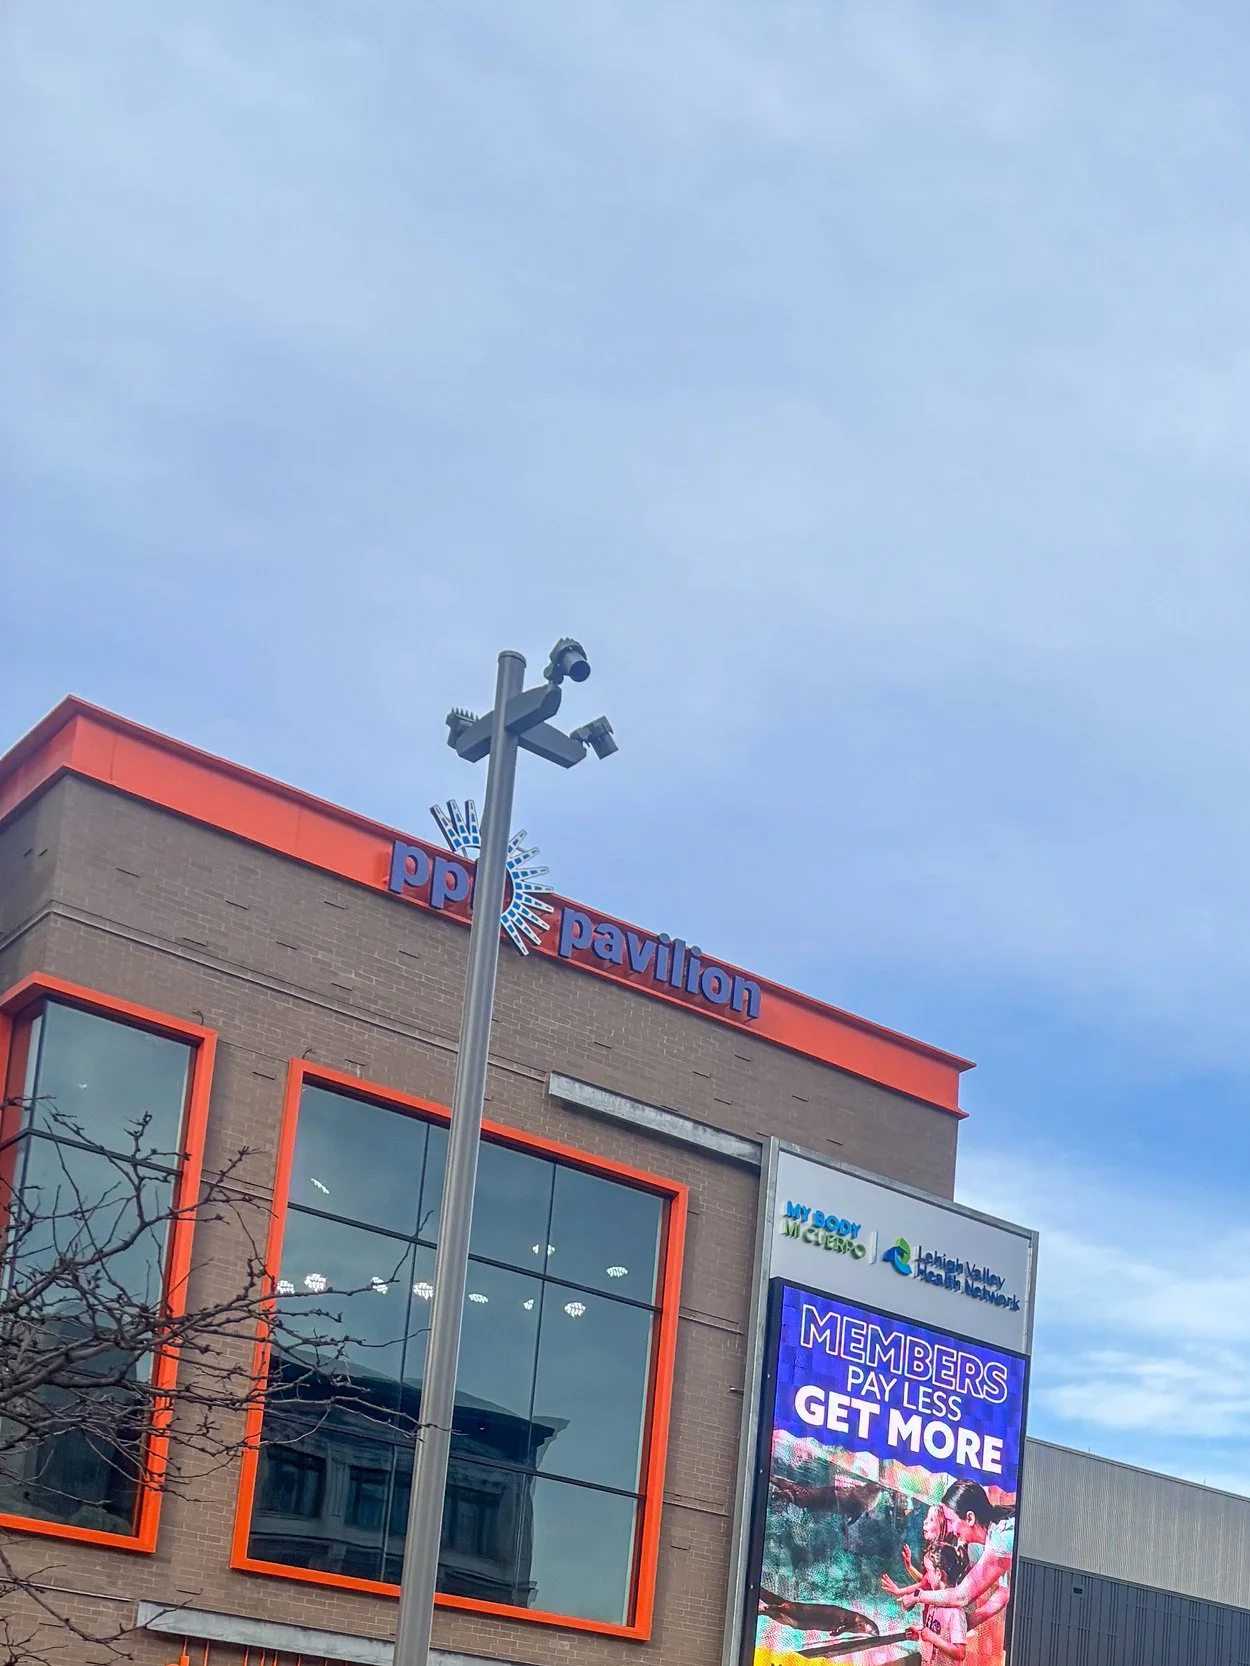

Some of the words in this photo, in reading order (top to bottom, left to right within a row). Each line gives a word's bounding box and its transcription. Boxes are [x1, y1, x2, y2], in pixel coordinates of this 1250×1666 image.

[388, 839, 478, 910] pp
[559, 907, 762, 1018] pavilion
[783, 1219, 800, 1238] MI
[803, 1227, 867, 1260] CUERPO
[786, 1200, 810, 1222] MY
[814, 1210, 861, 1238] BODY
[916, 1246, 963, 1274] Lehigh
[965, 1261, 1006, 1289] Valley
[916, 1263, 961, 1292] Health
[963, 1279, 1020, 1312] Network
[801, 1305, 1008, 1404] MEMBERS
[848, 1366, 897, 1401] PAY
[903, 1384, 962, 1421] LESS
[794, 1385, 880, 1439] GET
[888, 1411, 1003, 1473] MORE
